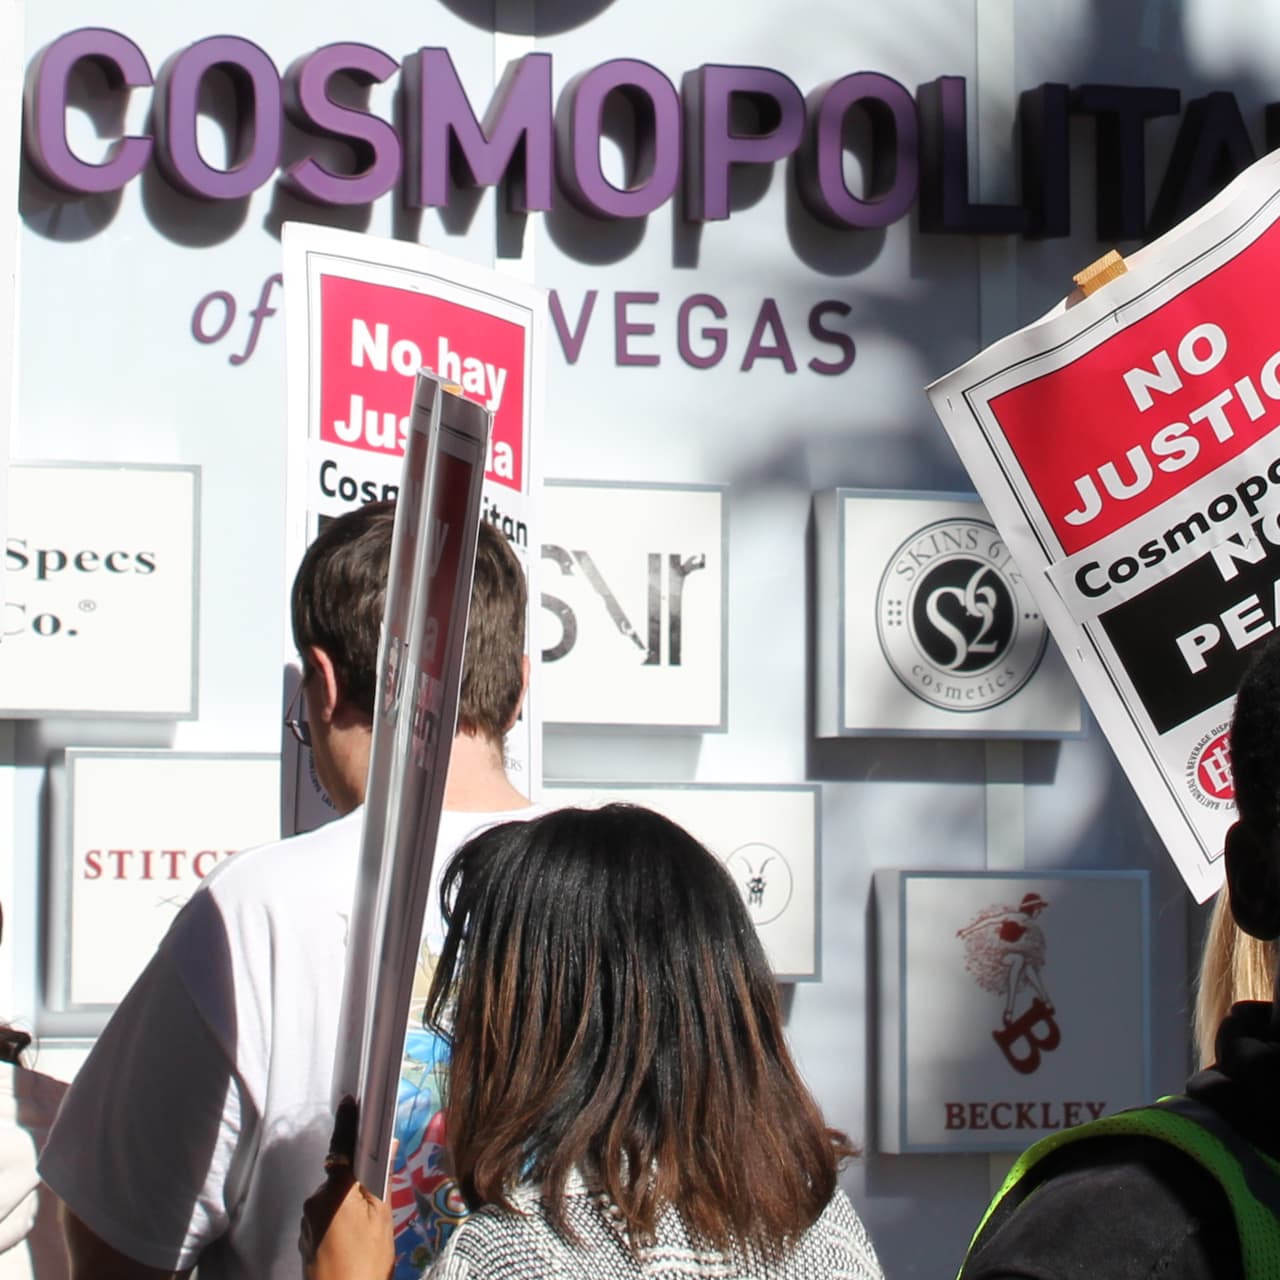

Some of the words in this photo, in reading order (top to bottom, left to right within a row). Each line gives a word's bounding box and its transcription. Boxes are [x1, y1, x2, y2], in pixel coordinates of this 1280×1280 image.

[191, 272, 283, 366] of
[548, 289, 857, 376] VEGAS
[351, 318, 422, 377] No
[438, 336, 507, 413] hay
[1122, 322, 1227, 412] NO
[896, 528, 979, 581] SKINS
[912, 664, 1016, 700] cosmetics
[84, 850, 237, 880] STITC
[944, 1101, 1106, 1130] BECKLEY
